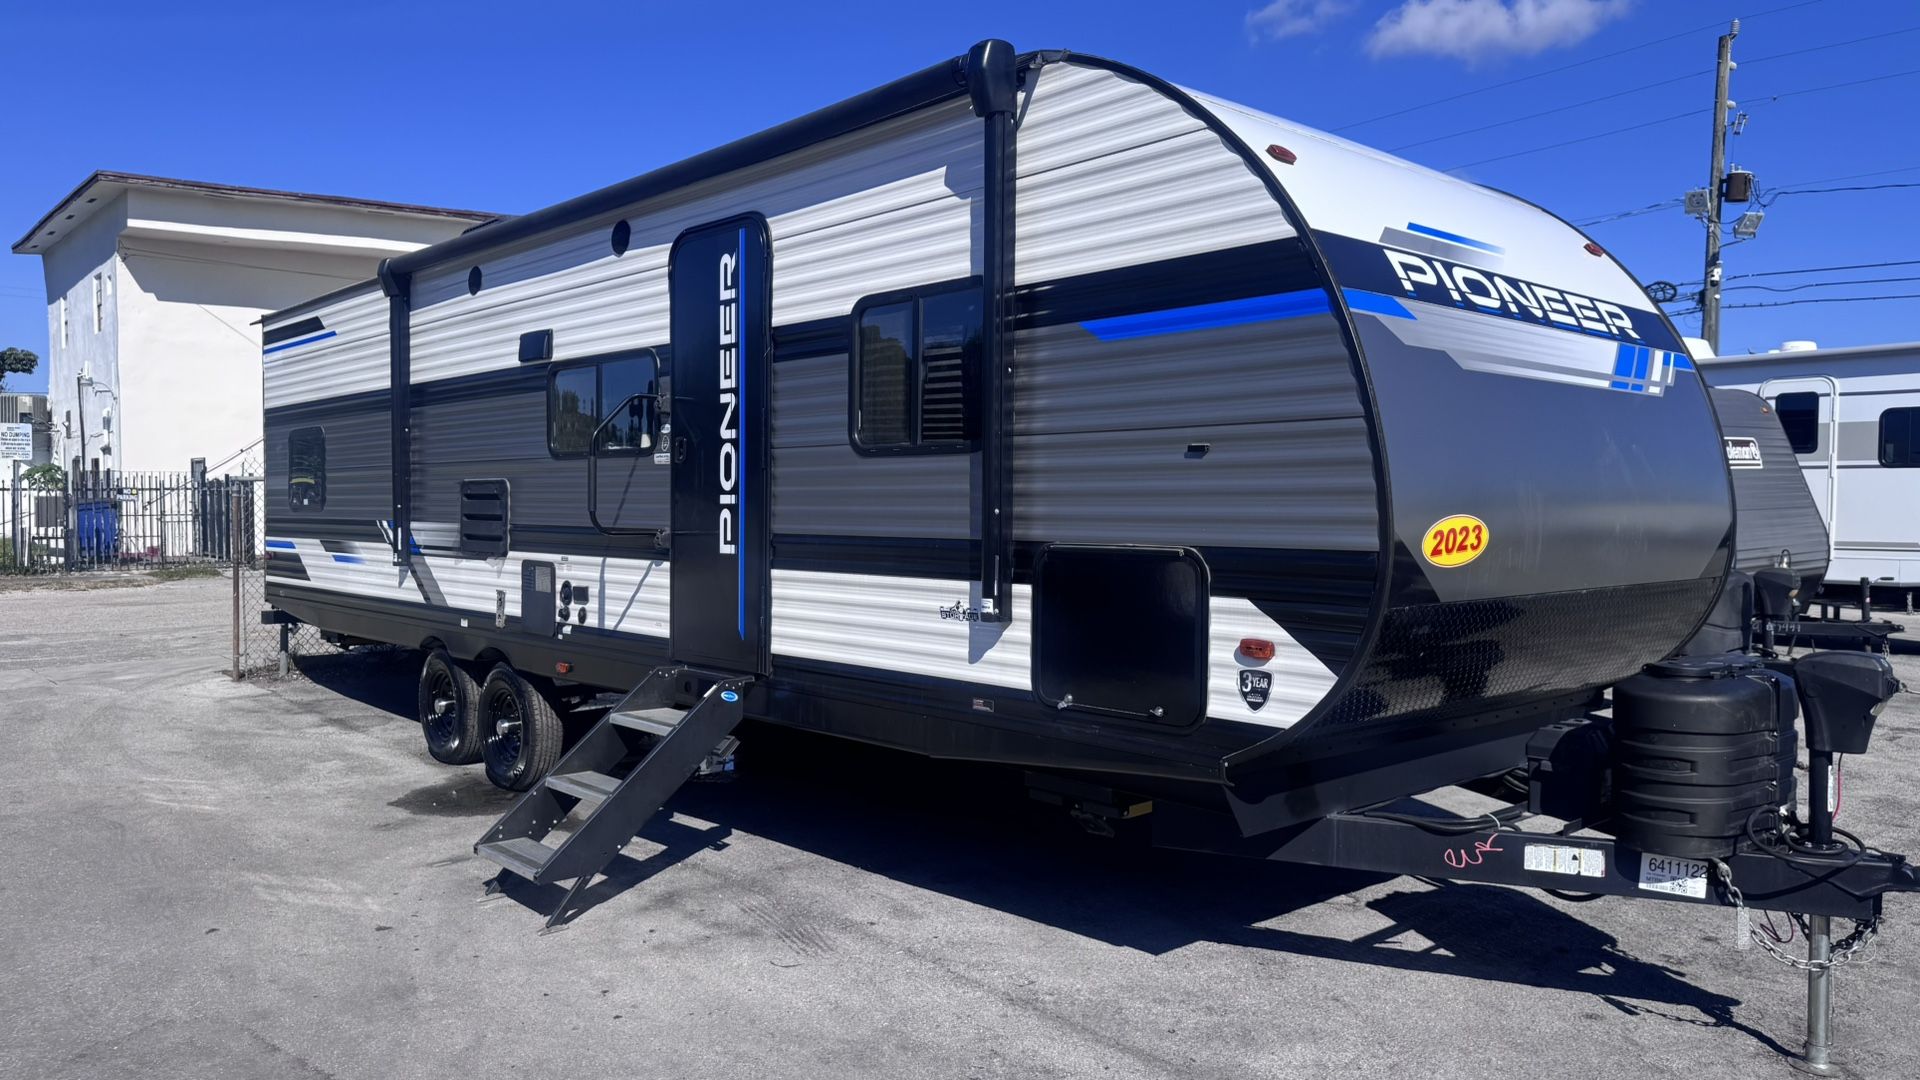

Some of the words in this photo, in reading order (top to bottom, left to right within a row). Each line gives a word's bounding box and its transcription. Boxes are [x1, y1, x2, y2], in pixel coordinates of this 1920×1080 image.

[1383, 248, 1641, 340] PIONEER
[719, 252, 737, 555] PIONEER
[1430, 524, 1483, 557] 2023
[1242, 672, 1252, 692] 3
[1252, 677, 1269, 689] YEAR
[1648, 857, 1708, 879] 6411122
